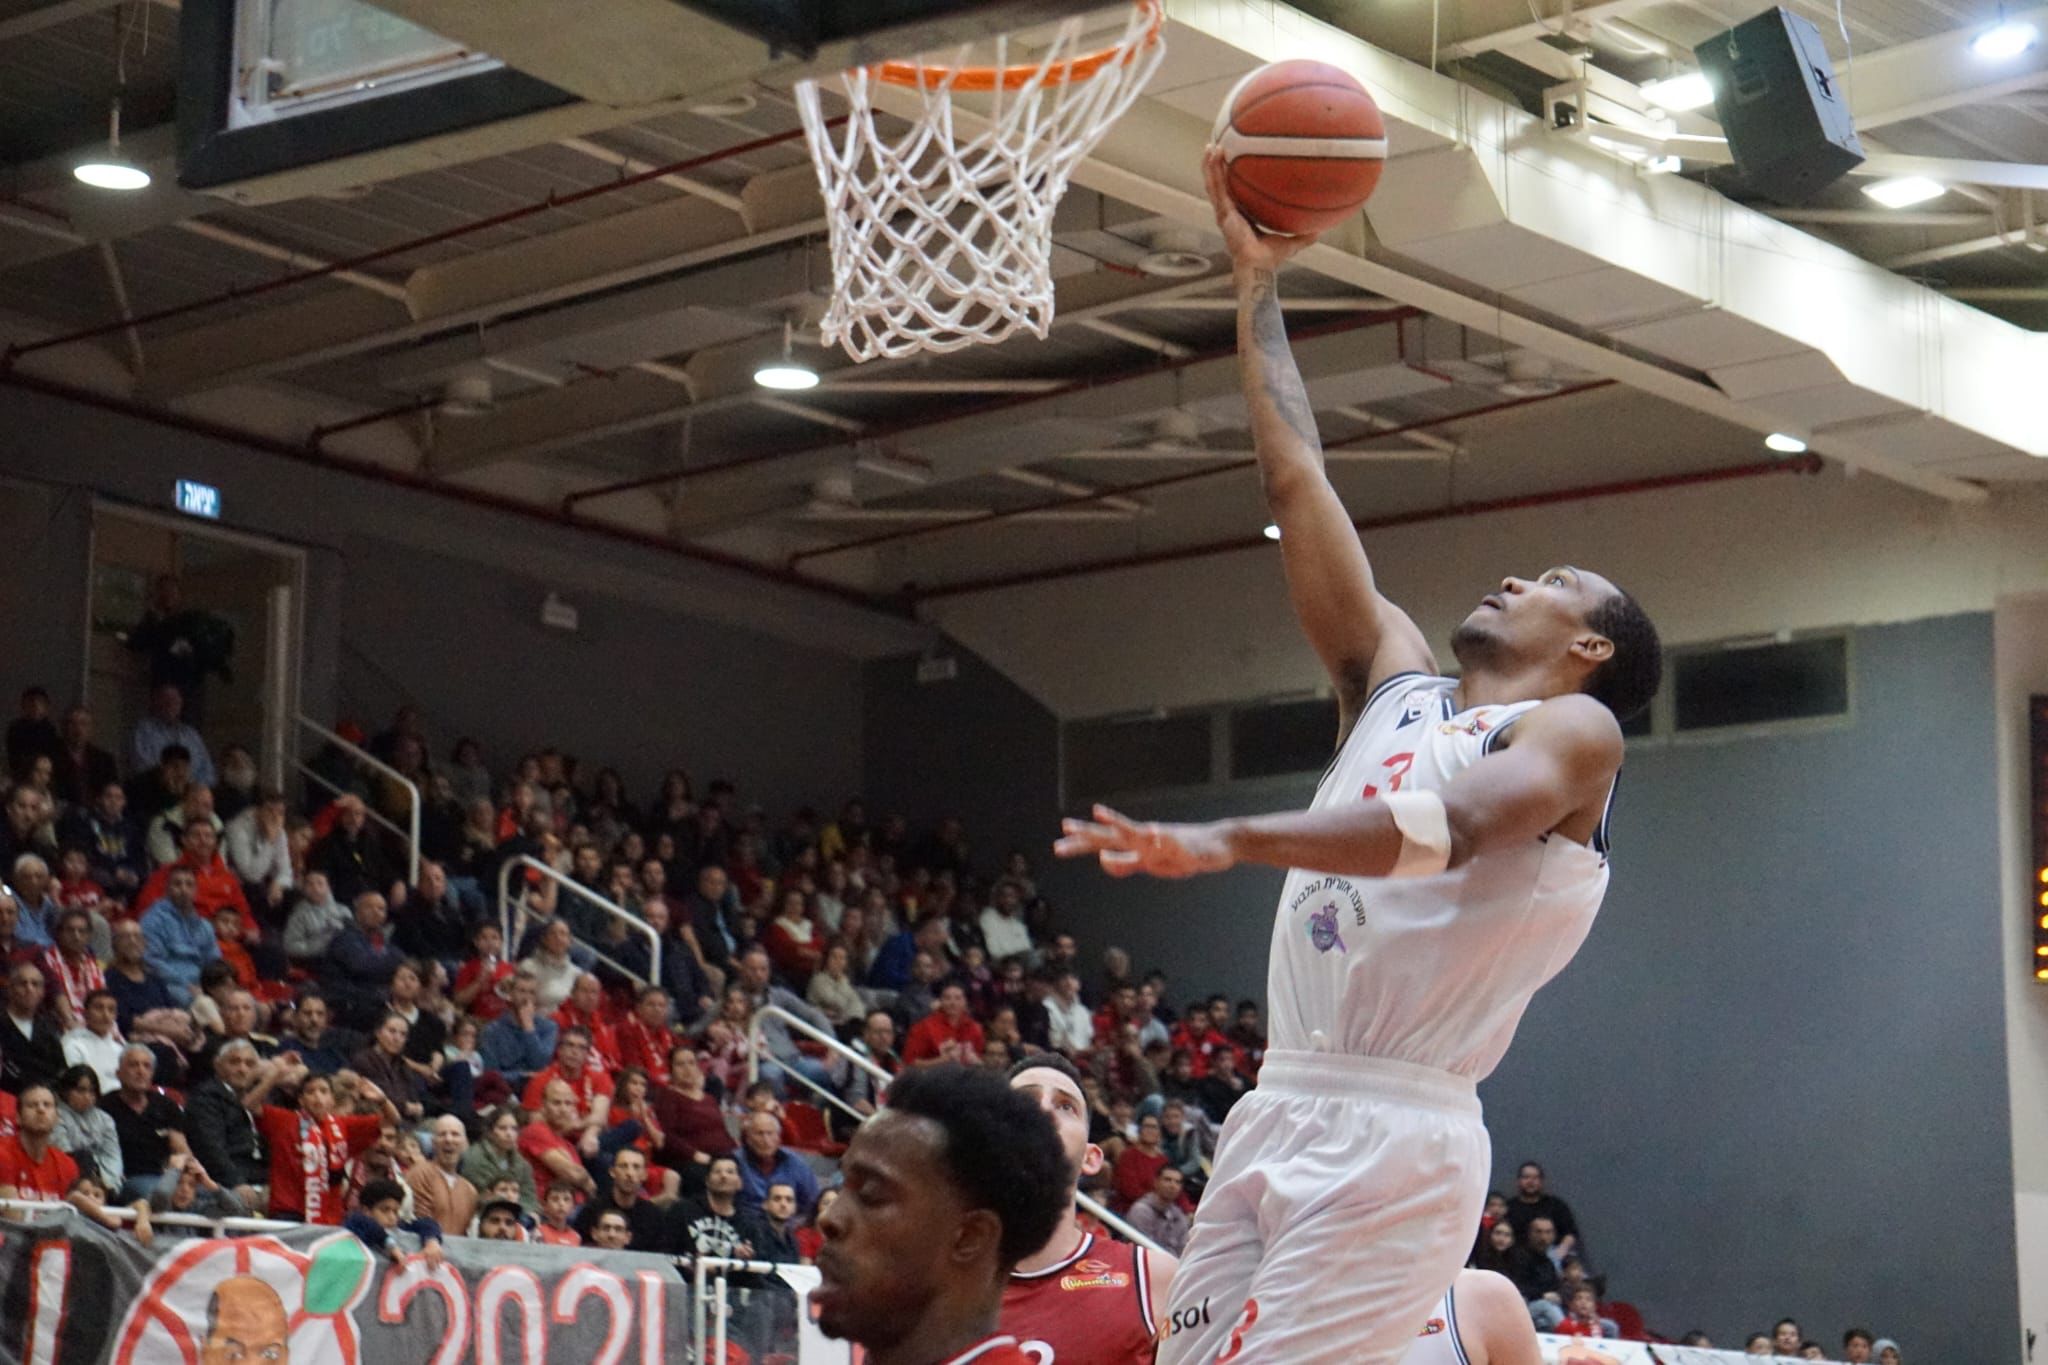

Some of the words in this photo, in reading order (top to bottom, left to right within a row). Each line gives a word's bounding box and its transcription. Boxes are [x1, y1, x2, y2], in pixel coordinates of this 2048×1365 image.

[1291, 880, 1321, 912] הגלבוע
[1323, 876, 1352, 896] אזורית
[1350, 889, 1367, 926] מועצה
[379, 1252, 665, 1365] 2021
